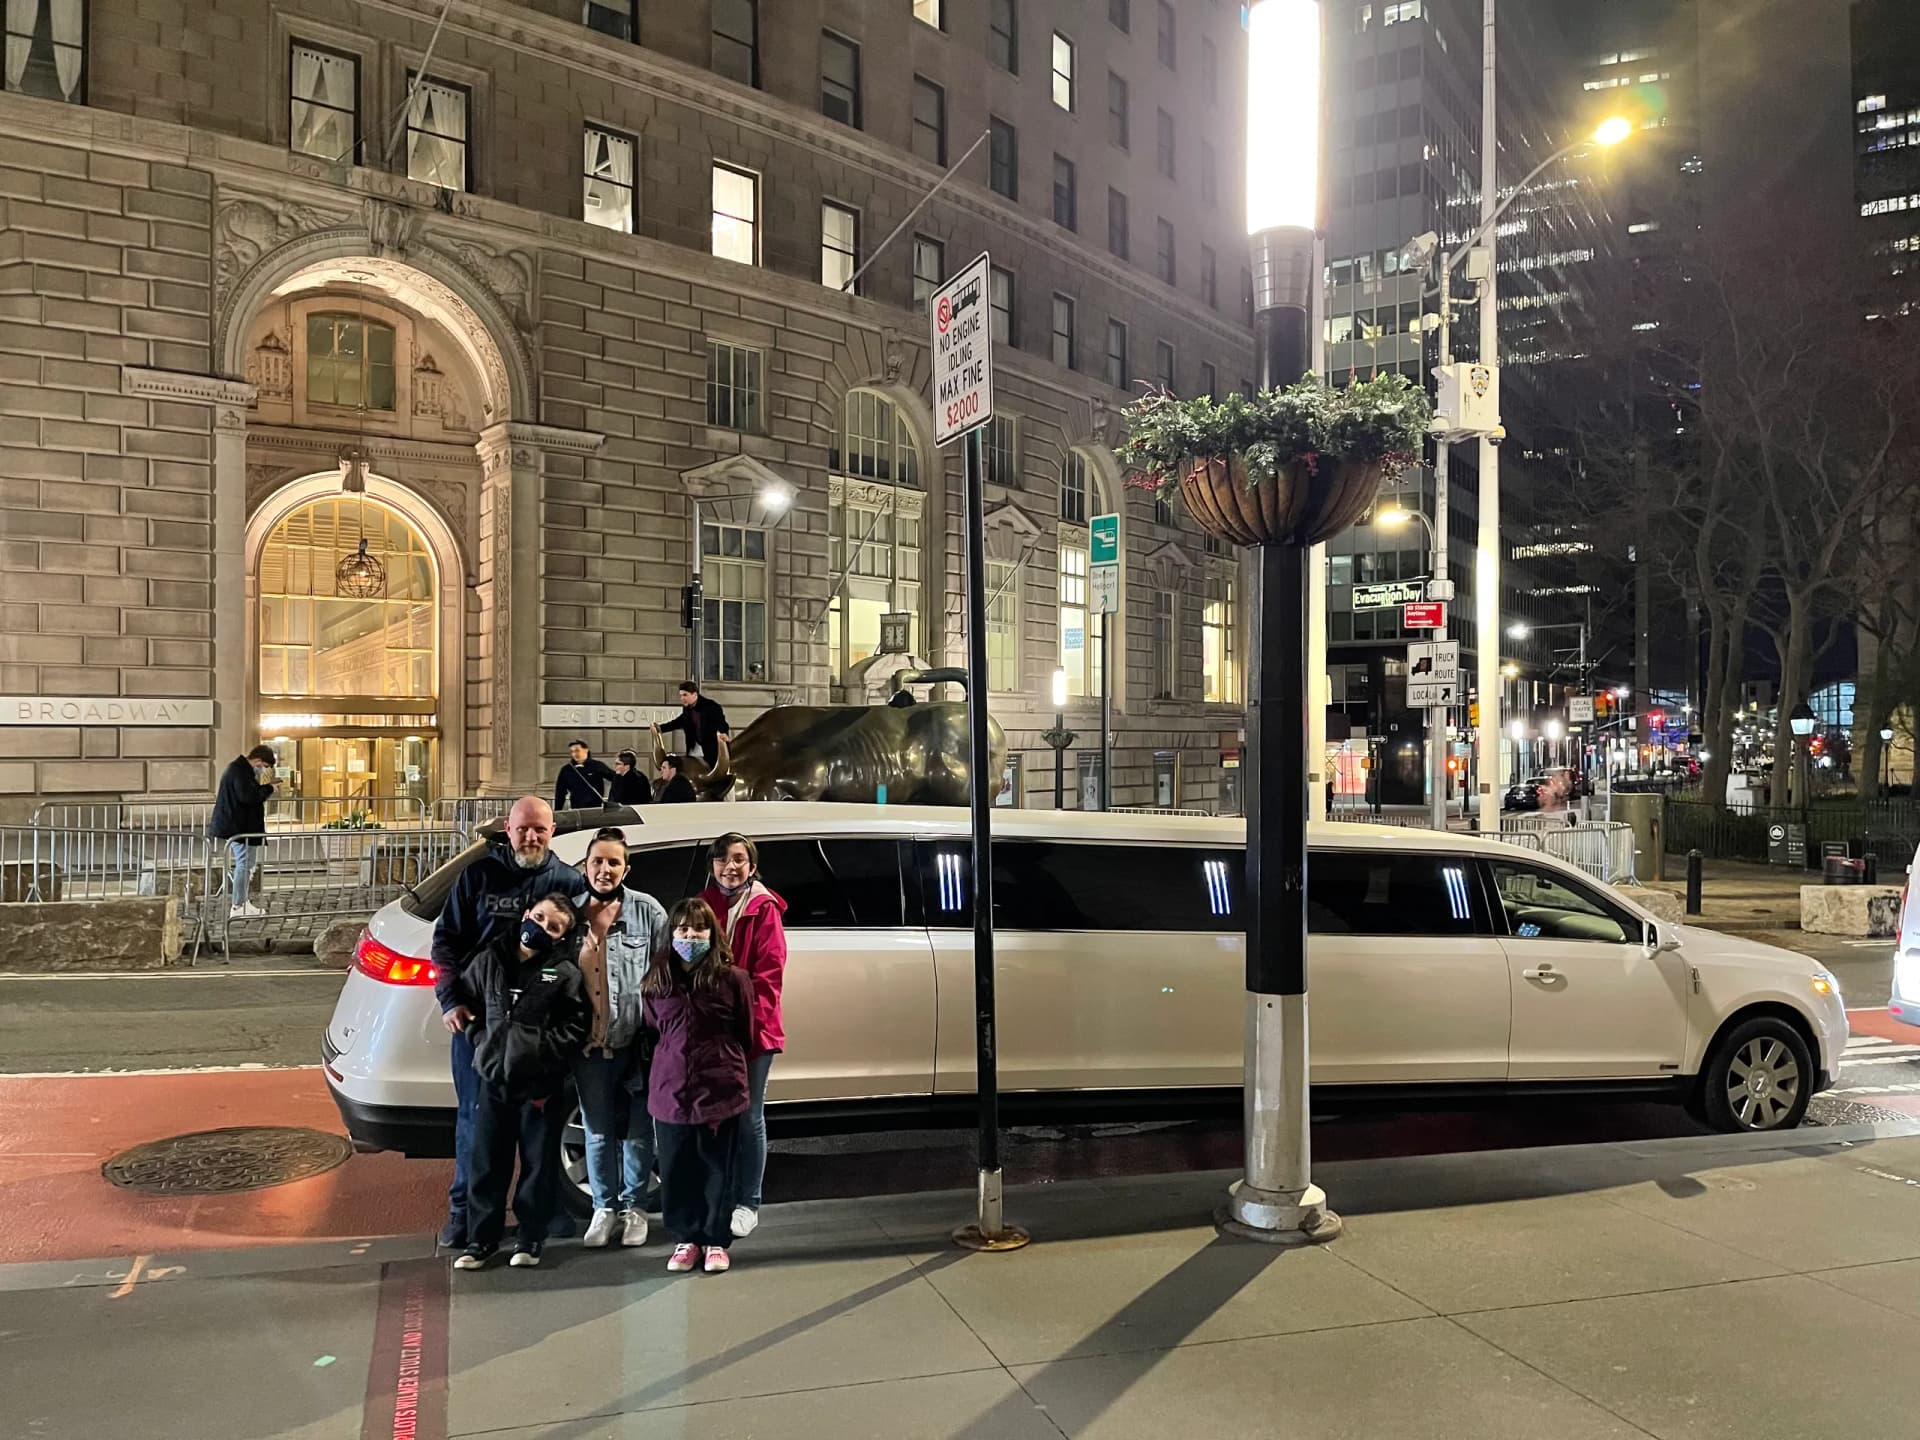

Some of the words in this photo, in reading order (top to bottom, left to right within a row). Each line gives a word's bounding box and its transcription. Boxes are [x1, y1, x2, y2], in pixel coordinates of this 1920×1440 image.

[939, 335, 950, 355] NO
[952, 311, 981, 346] ENGINE
[948, 342, 973, 372] IDLING
[939, 376, 959, 404] MAX
[962, 360, 983, 393] FINE
[947, 391, 979, 429] $2000
[1355, 589, 1402, 605] Evacuation
[1403, 587, 1421, 602] Day
[1435, 652, 1455, 663] TRUCK
[1434, 669, 1455, 679] ROUTE
[1412, 690, 1433, 700] LOCAL
[18, 702, 189, 721] BROADWAY
[597, 709, 679, 724] BROADW
[401, 1332, 422, 1347] AND
[399, 1348, 421, 1375] STULTZ
[395, 1376, 419, 1410] WILMER
[393, 1410, 417, 1440] PILOTS
